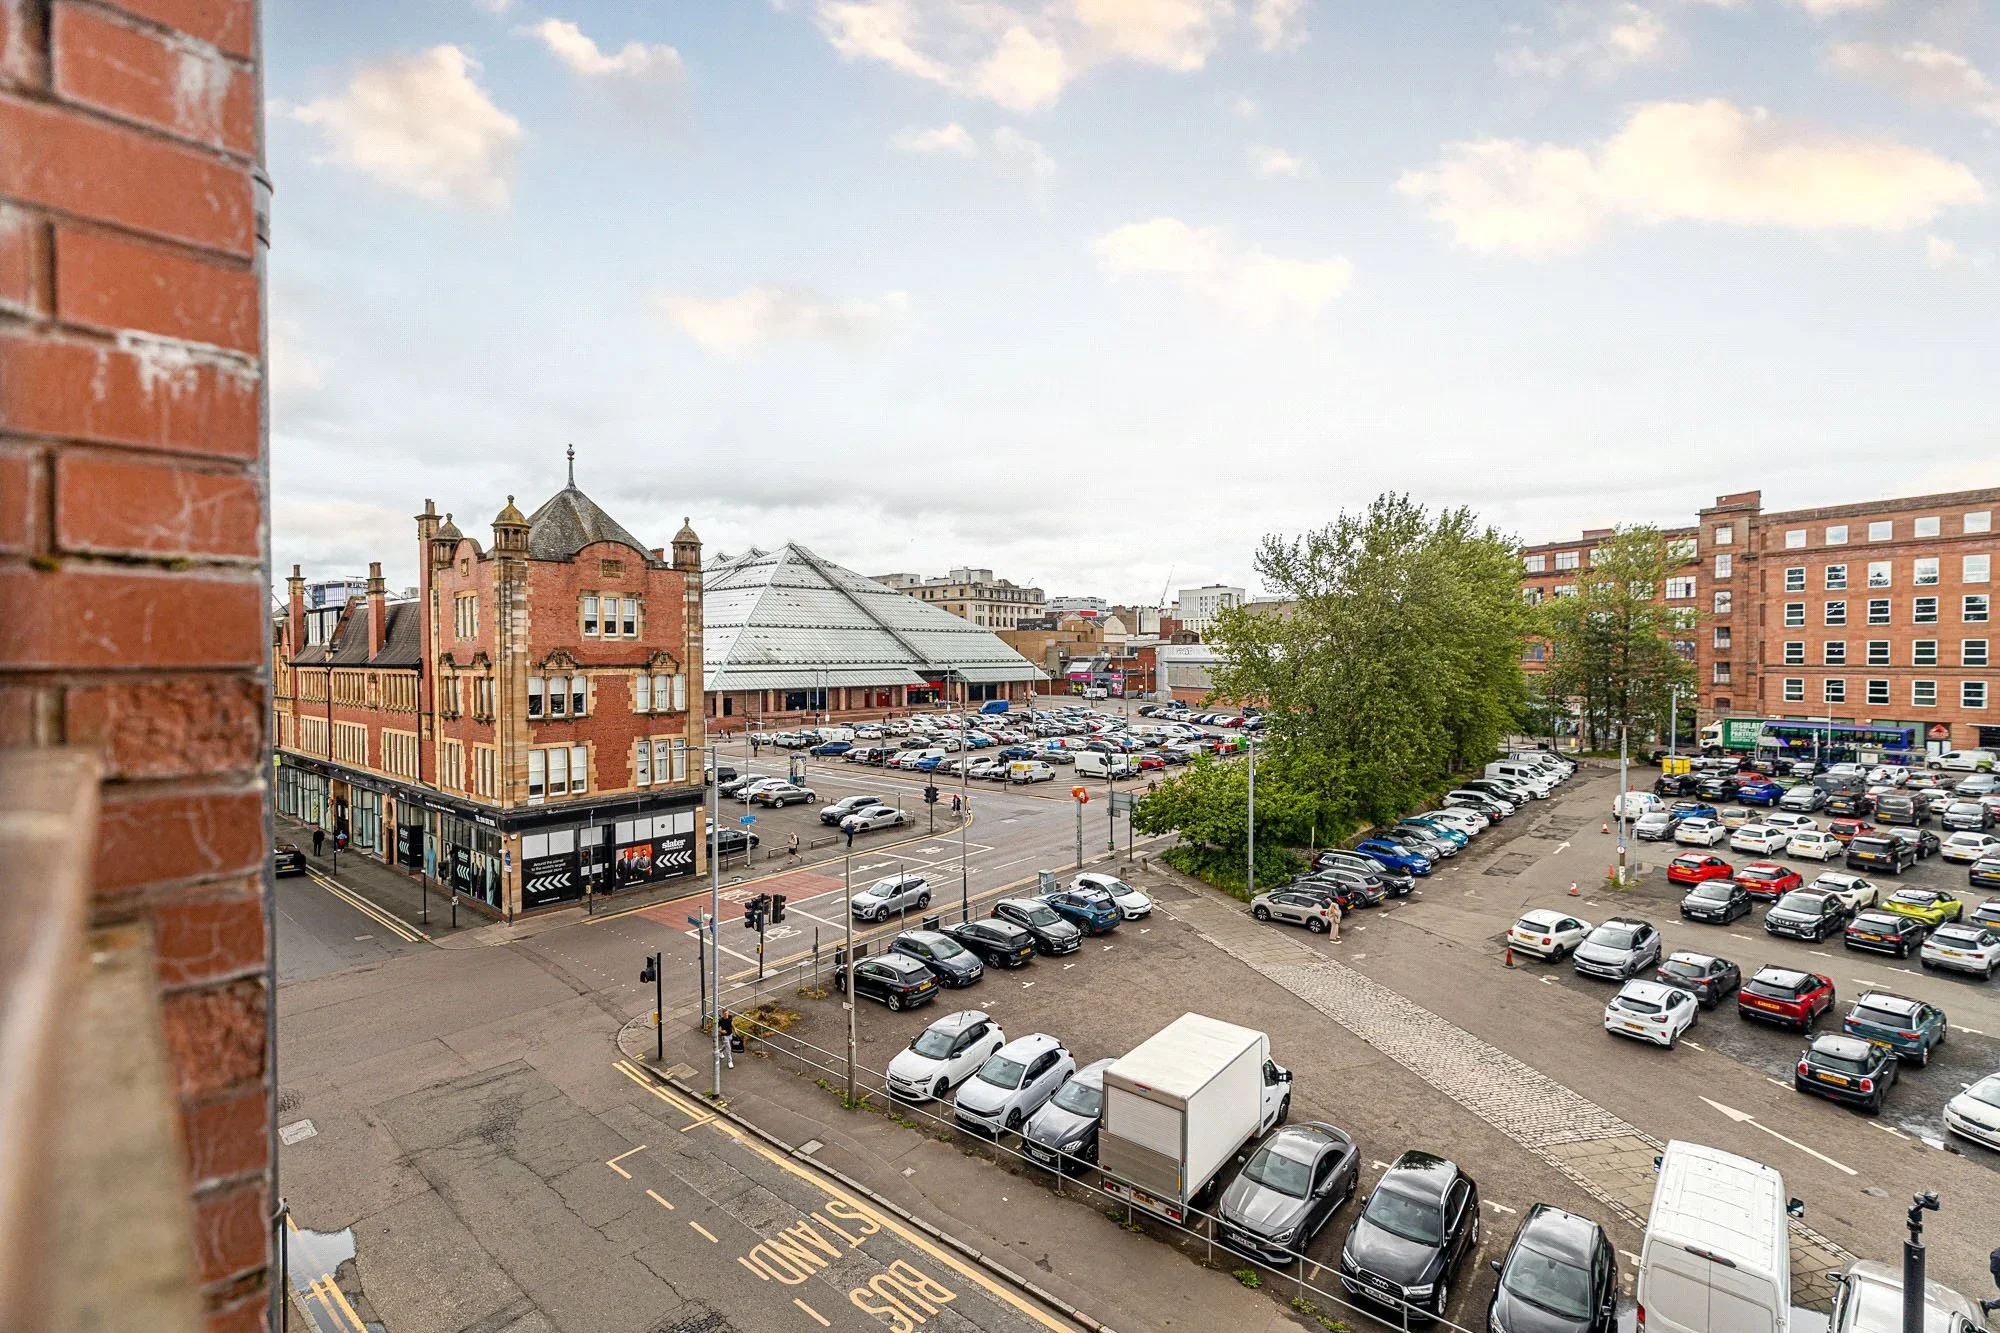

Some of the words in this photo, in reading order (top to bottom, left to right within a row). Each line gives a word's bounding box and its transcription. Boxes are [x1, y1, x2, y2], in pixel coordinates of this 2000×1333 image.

[662, 839, 686, 849] slater
[748, 1200, 881, 1285] STAND
[849, 1258, 957, 1333] BUS
